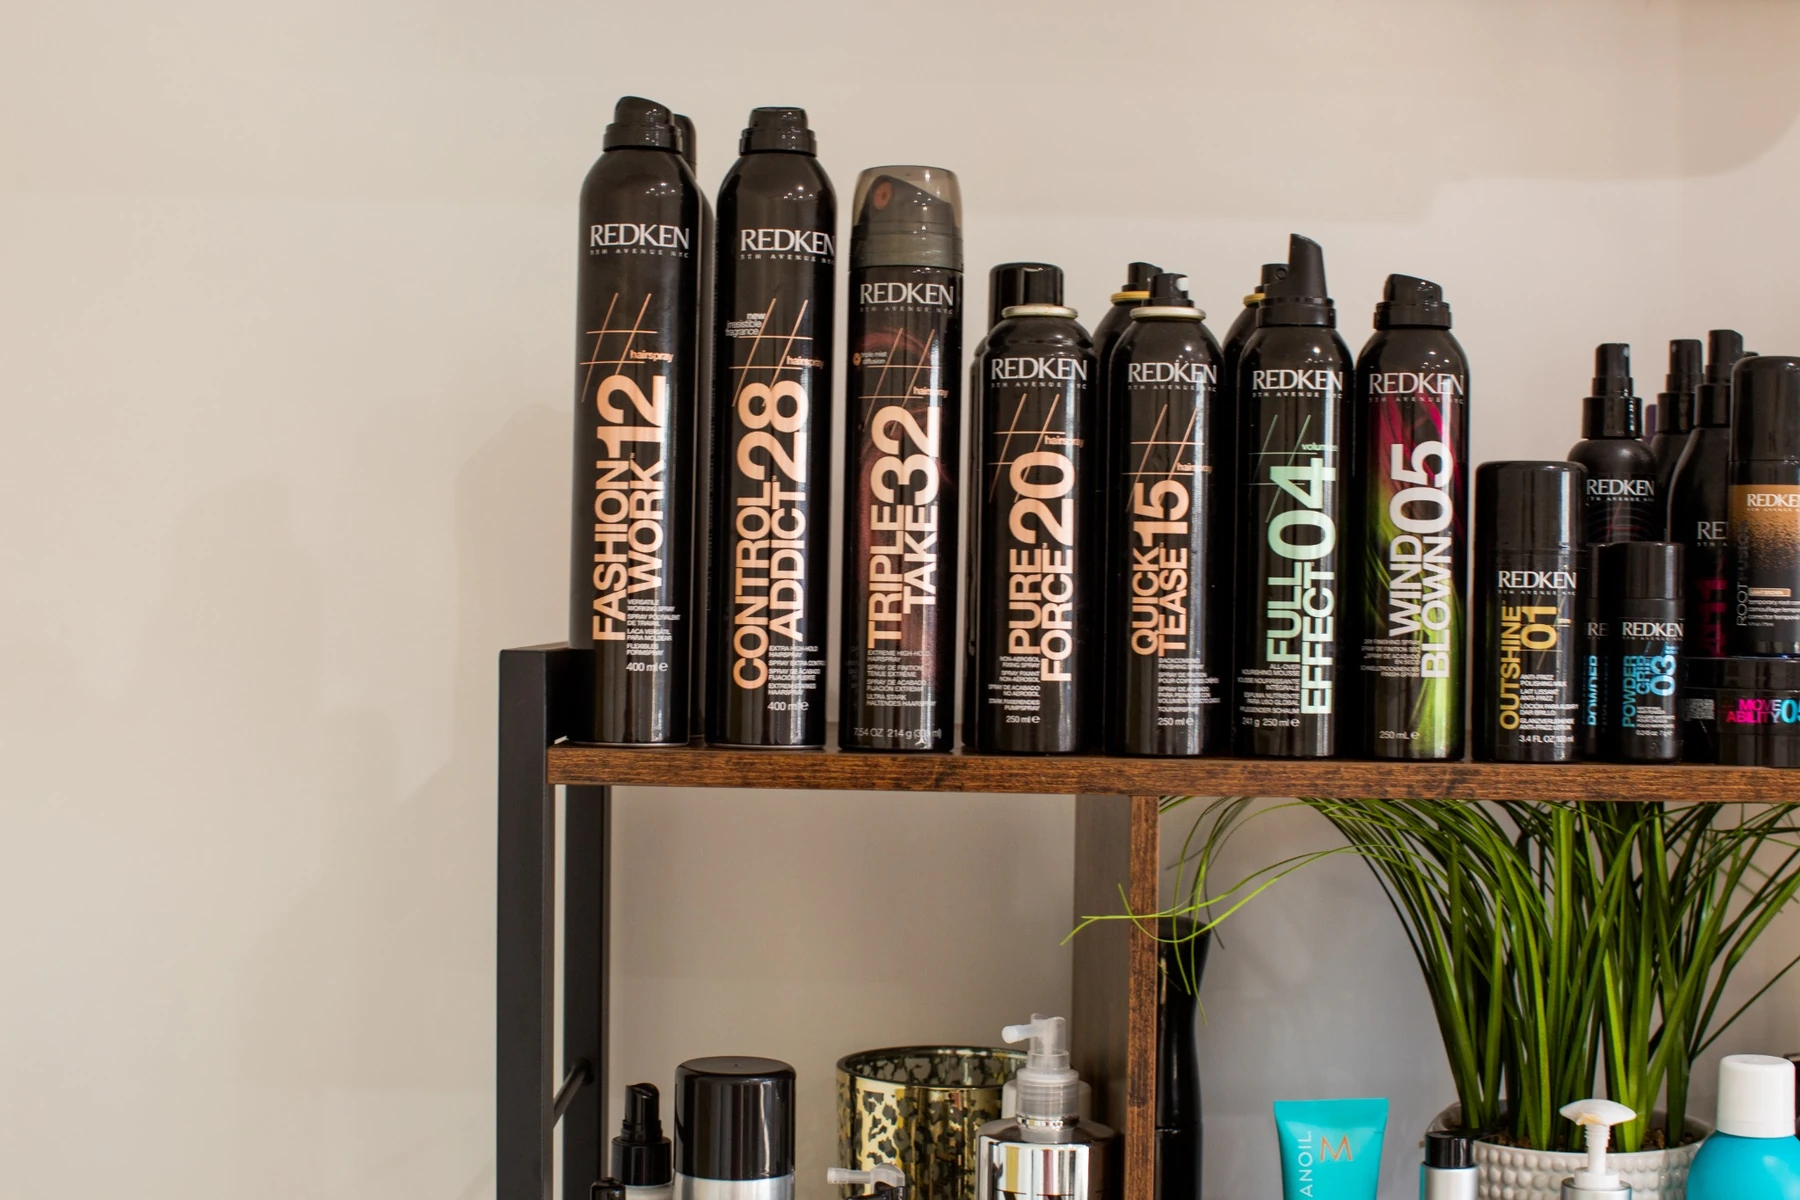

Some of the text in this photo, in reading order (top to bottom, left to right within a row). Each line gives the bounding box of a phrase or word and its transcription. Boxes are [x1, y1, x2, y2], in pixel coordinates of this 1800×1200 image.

[590, 223, 689, 249] REDKEN
[740, 229, 834, 256] REDKEN
[770, 254, 816, 262] AVENUE
[860, 283, 954, 306] REDKEN
[629, 350, 674, 363] hairspray
[786, 356, 824, 369] hairspray
[991, 357, 1088, 381] REDKEN
[1128, 362, 1217, 384] REDKEN
[1252, 369, 1343, 390] REDKEN
[1369, 373, 1464, 395] REDKEN
[596, 374, 667, 458] 12
[736, 380, 809, 483] 28
[870, 405, 941, 506] 32
[1009, 451, 1075, 546] 20
[1267, 457, 1336, 561] 04
[1389, 441, 1453, 534] 05
[1586, 479, 1655, 496] REDKEN
[1747, 494, 1800, 507] REDKE
[627, 459, 664, 593] WORK
[1133, 479, 1189, 547] 15
[593, 461, 629, 640] FASHION
[769, 482, 807, 642] ADDICT
[903, 505, 938, 614] TAKE
[733, 482, 771, 690] CONTROL
[868, 504, 904, 648] TRIPLE
[1389, 535, 1422, 637] WIND
[1498, 571, 1576, 589] REDKEN
[1008, 549, 1042, 654] PURE
[1041, 549, 1073, 681] FORCE
[1131, 546, 1160, 655] QUICK
[1158, 548, 1188, 657] TEASE
[1266, 562, 1302, 662] FULL
[1421, 536, 1452, 678] BLOWN
[1736, 581, 1748, 626] ROOT
[1301, 562, 1335, 714] EFFECT
[1520, 606, 1558, 650] 01
[1622, 622, 1683, 637] REDKEN
[626, 662, 645, 671] 400
[1500, 606, 1522, 730] OUTSHINE
[1636, 655, 1651, 695] GRIP
[1650, 654, 1676, 696] 03
[767, 701, 786, 711] 400
[1622, 655, 1636, 727] POWDER
[1739, 699, 1800, 723] MOVE 0
[870, 728, 912, 739] OZ 214 g
[1006, 715, 1020, 723] 250
[1157, 717, 1174, 725] 250
[1254, 719, 1260, 727] g
[1262, 718, 1278, 726] 250
[1379, 730, 1395, 739] 250
[1726, 711, 1780, 723] ABILITY
[1532, 735, 1543, 743] FL
[1298, 1131, 1313, 1197] ANOIL
